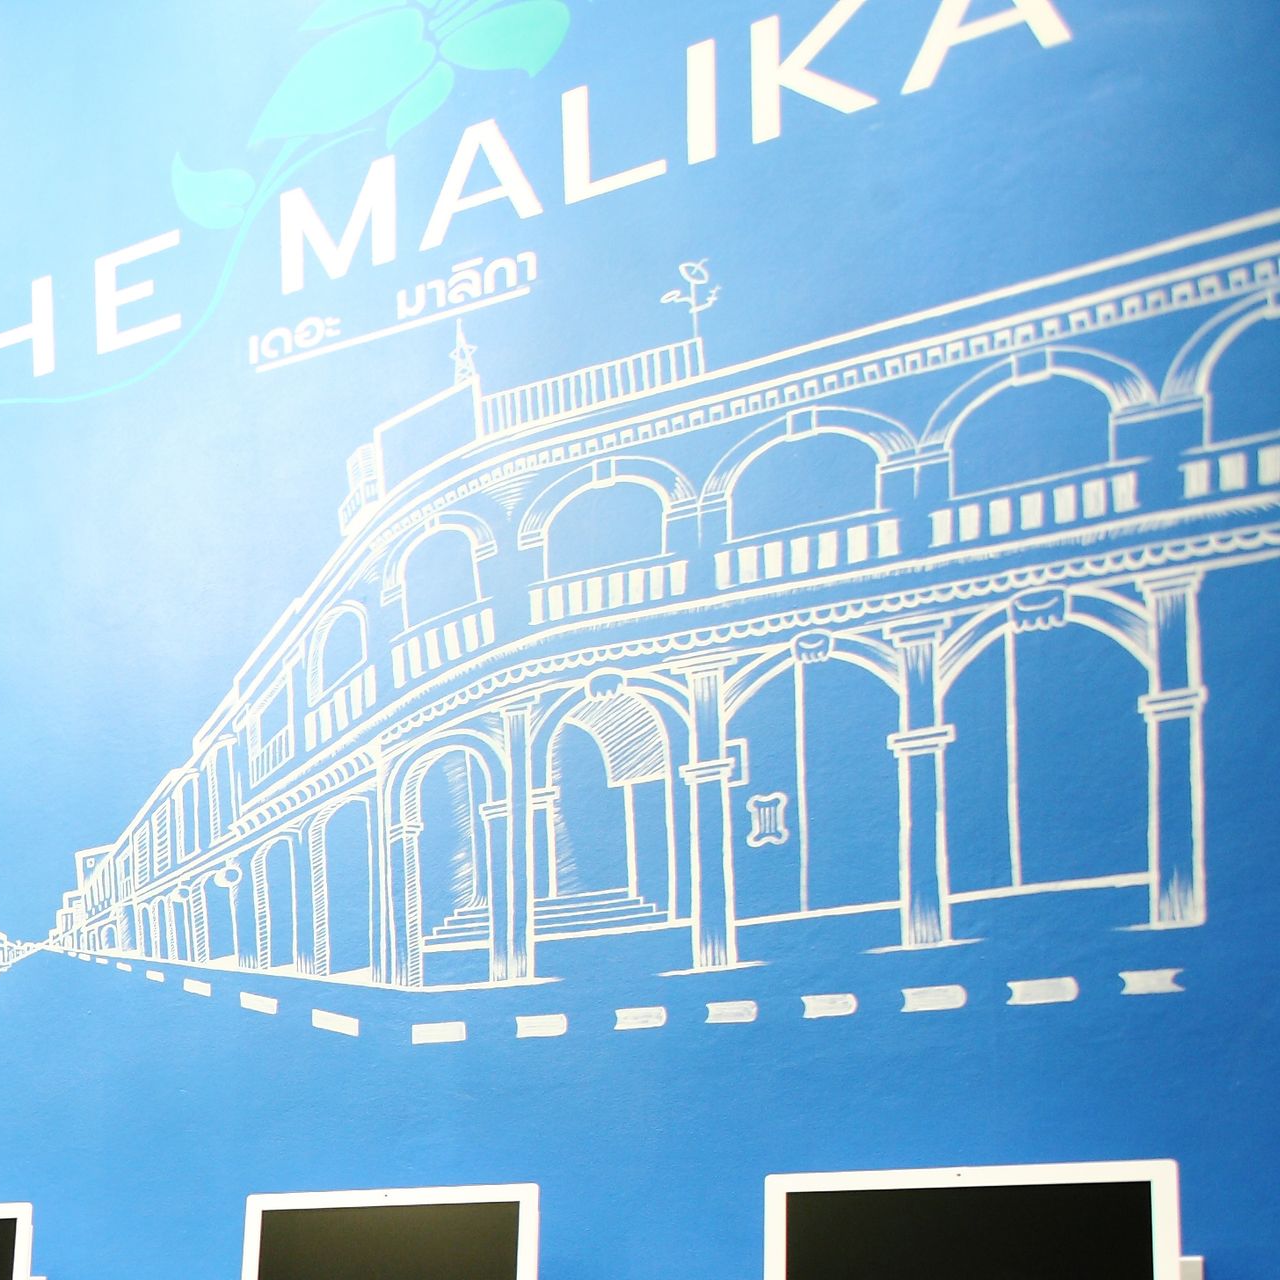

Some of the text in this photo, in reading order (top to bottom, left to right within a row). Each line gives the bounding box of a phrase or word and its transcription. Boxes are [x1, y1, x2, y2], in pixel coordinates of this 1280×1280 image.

[279, 0, 1072, 296] MALIKA
[248, 250, 538, 365] เดอะ มาลิกา
